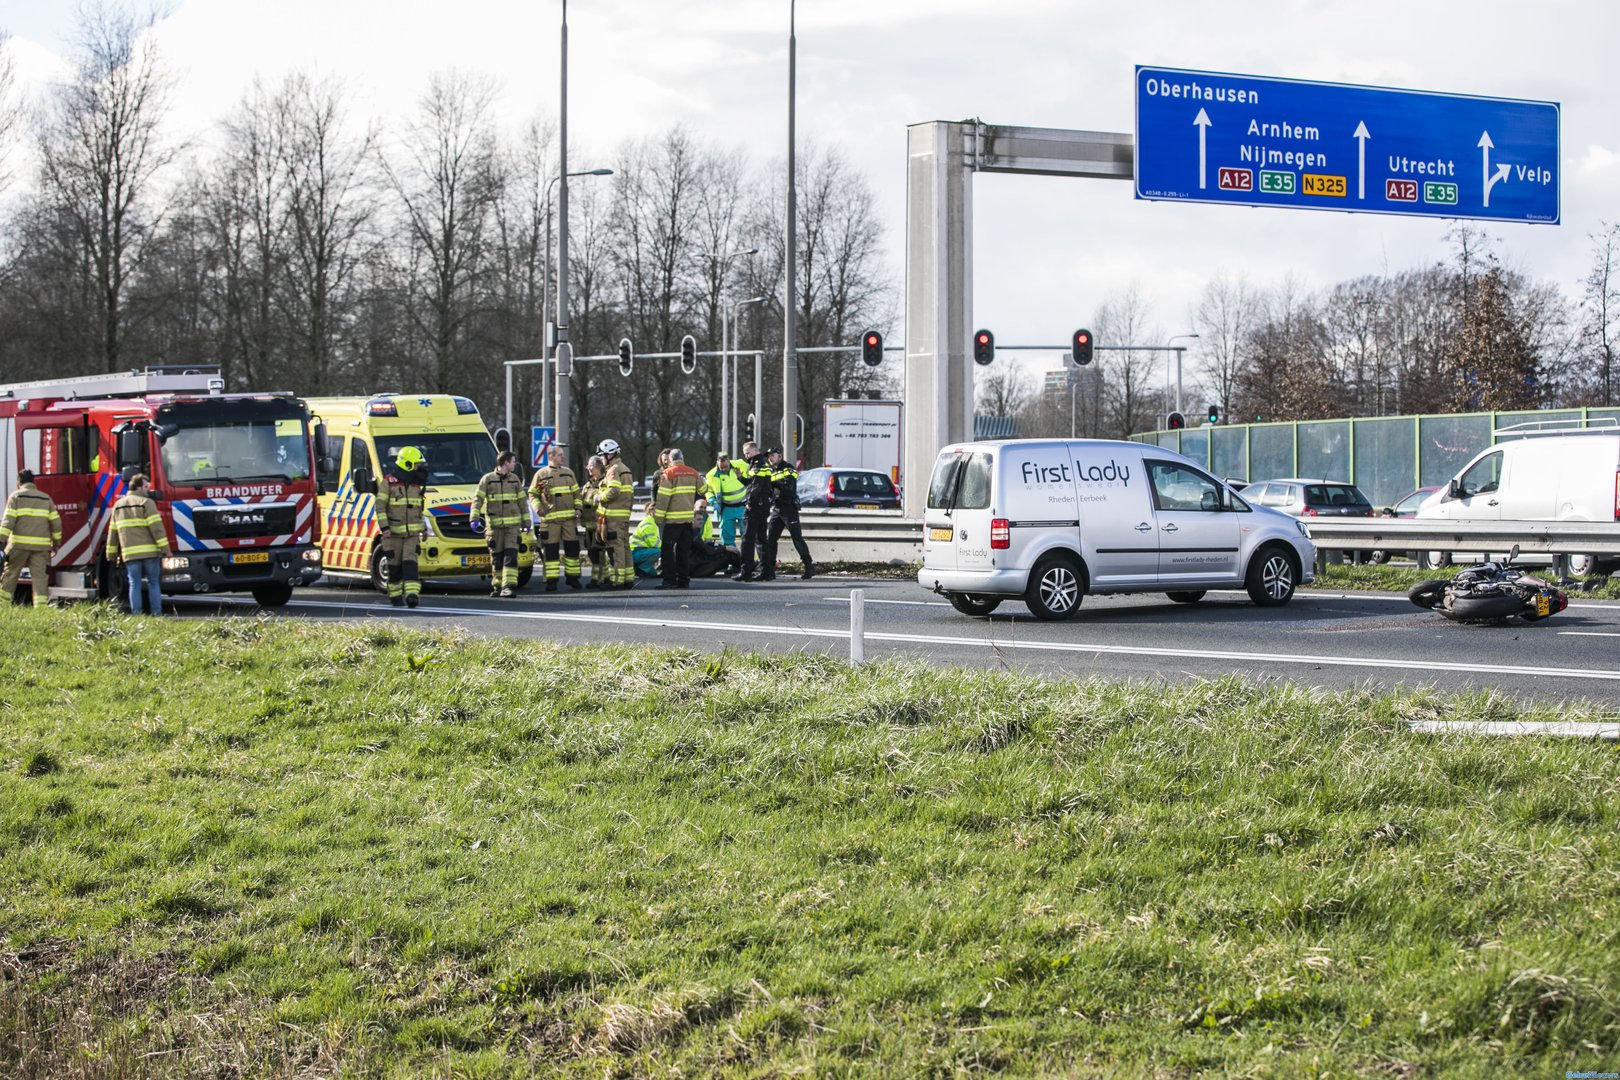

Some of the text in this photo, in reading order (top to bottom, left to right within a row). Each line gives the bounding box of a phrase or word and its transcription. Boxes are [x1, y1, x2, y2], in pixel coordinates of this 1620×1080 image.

[1146, 78, 1259, 104] Oberhausen
[1247, 118, 1320, 141] Arnhem
[1240, 144, 1327, 171] Nijmegen
[1389, 155, 1455, 177] Utrecht
[1221, 172, 1250, 188] A12
[1516, 164, 1552, 186] Velp
[1388, 182, 1416, 199] A12
[206, 485, 283, 498] BRANDWEER
[1048, 494, 1107, 504] Rheden Eerbeek
[228, 515, 265, 524] MAN
[467, 556, 491, 564] PS-988
